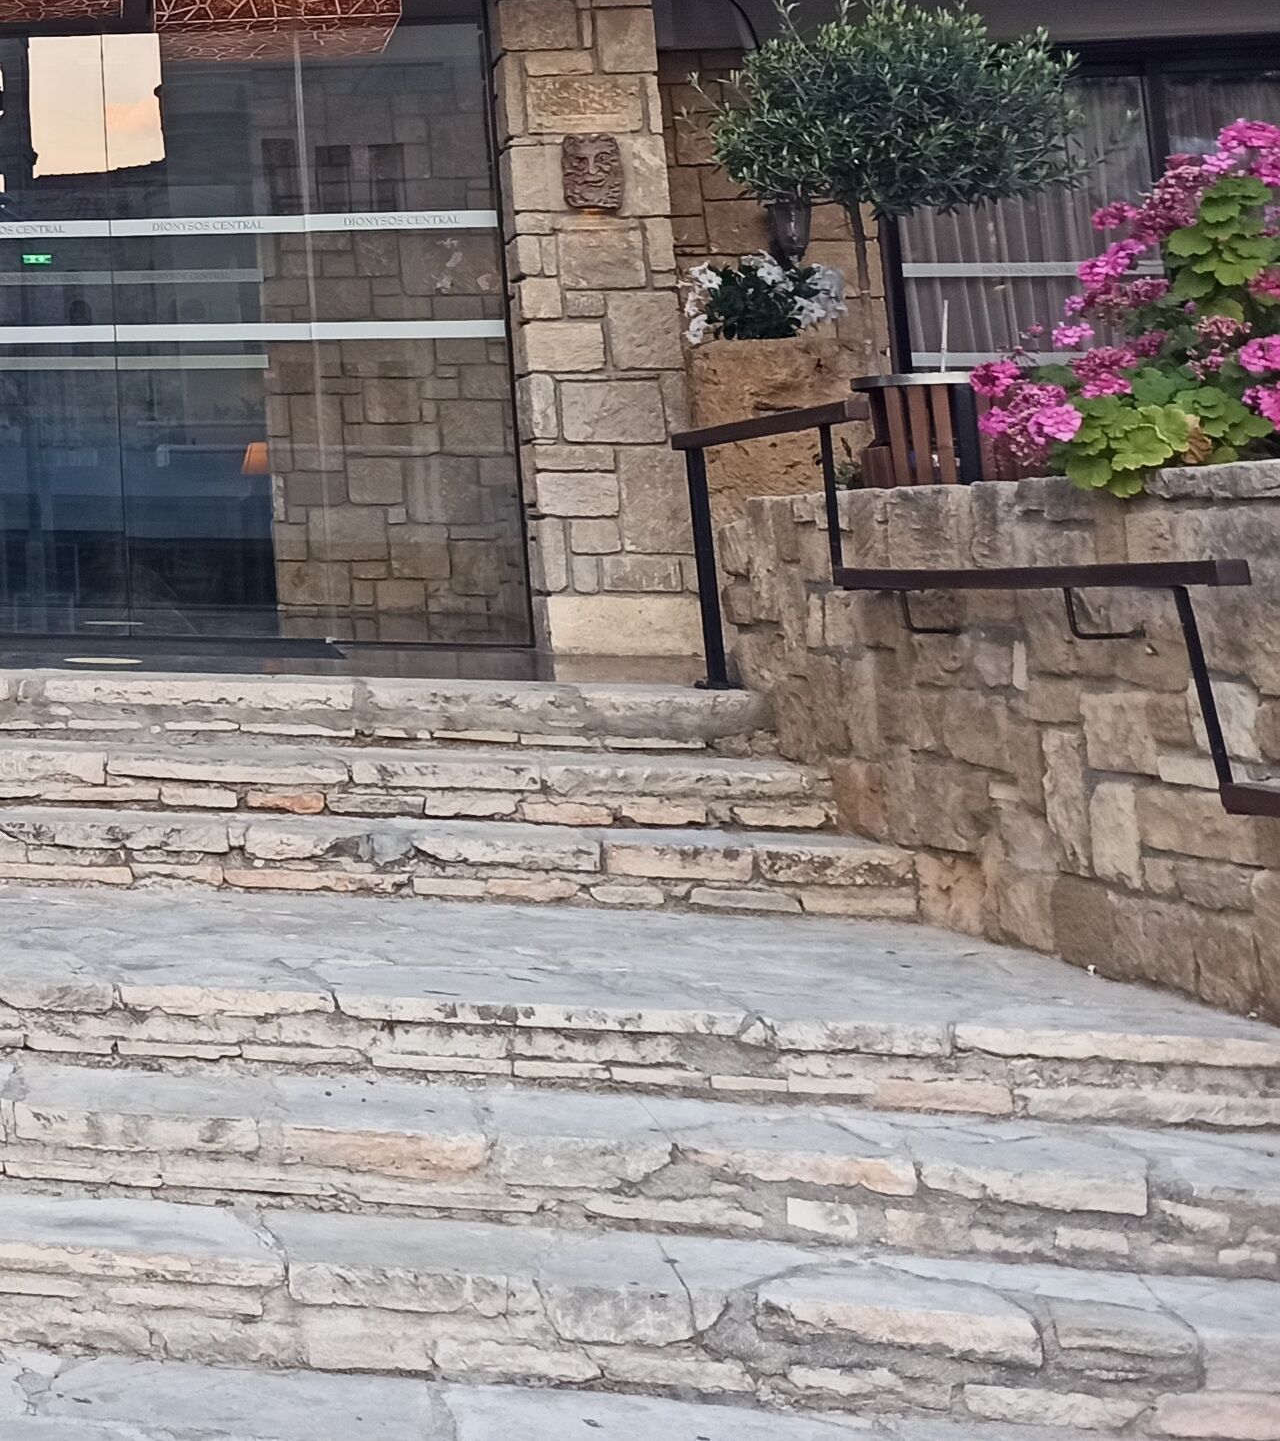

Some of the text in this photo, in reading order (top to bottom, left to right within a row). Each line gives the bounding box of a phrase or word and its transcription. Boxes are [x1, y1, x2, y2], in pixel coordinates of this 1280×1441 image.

[151, 220, 264, 232] DIONYSOS CENTRAL
[343, 214, 461, 227] DIONYSOS CENTRAL
[16, 225, 66, 235] CENTRAL
